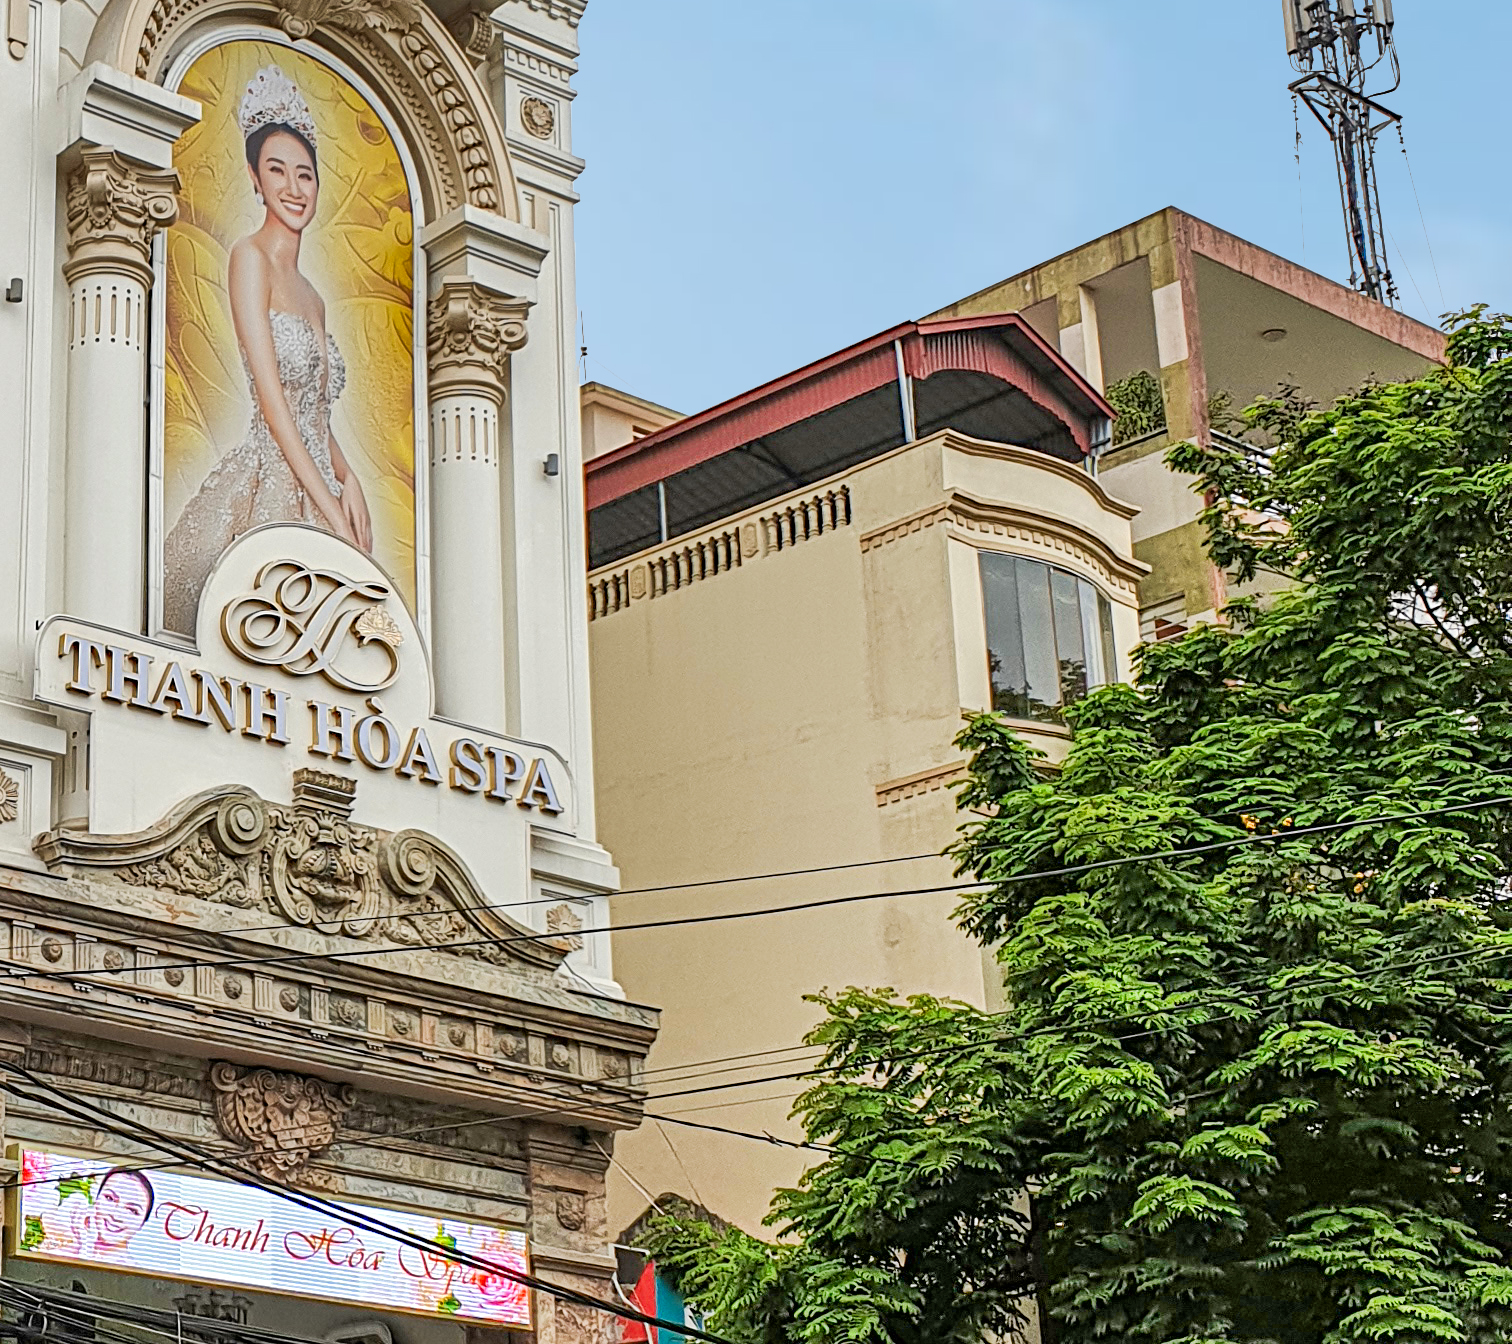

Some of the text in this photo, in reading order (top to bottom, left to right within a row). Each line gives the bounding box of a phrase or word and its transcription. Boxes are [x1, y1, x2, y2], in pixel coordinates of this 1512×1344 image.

[59, 632, 565, 813] THANH HÒA SPA
[155, 1201, 270, 1254] Thanh
[283, 1224, 385, 1271] Hòa
